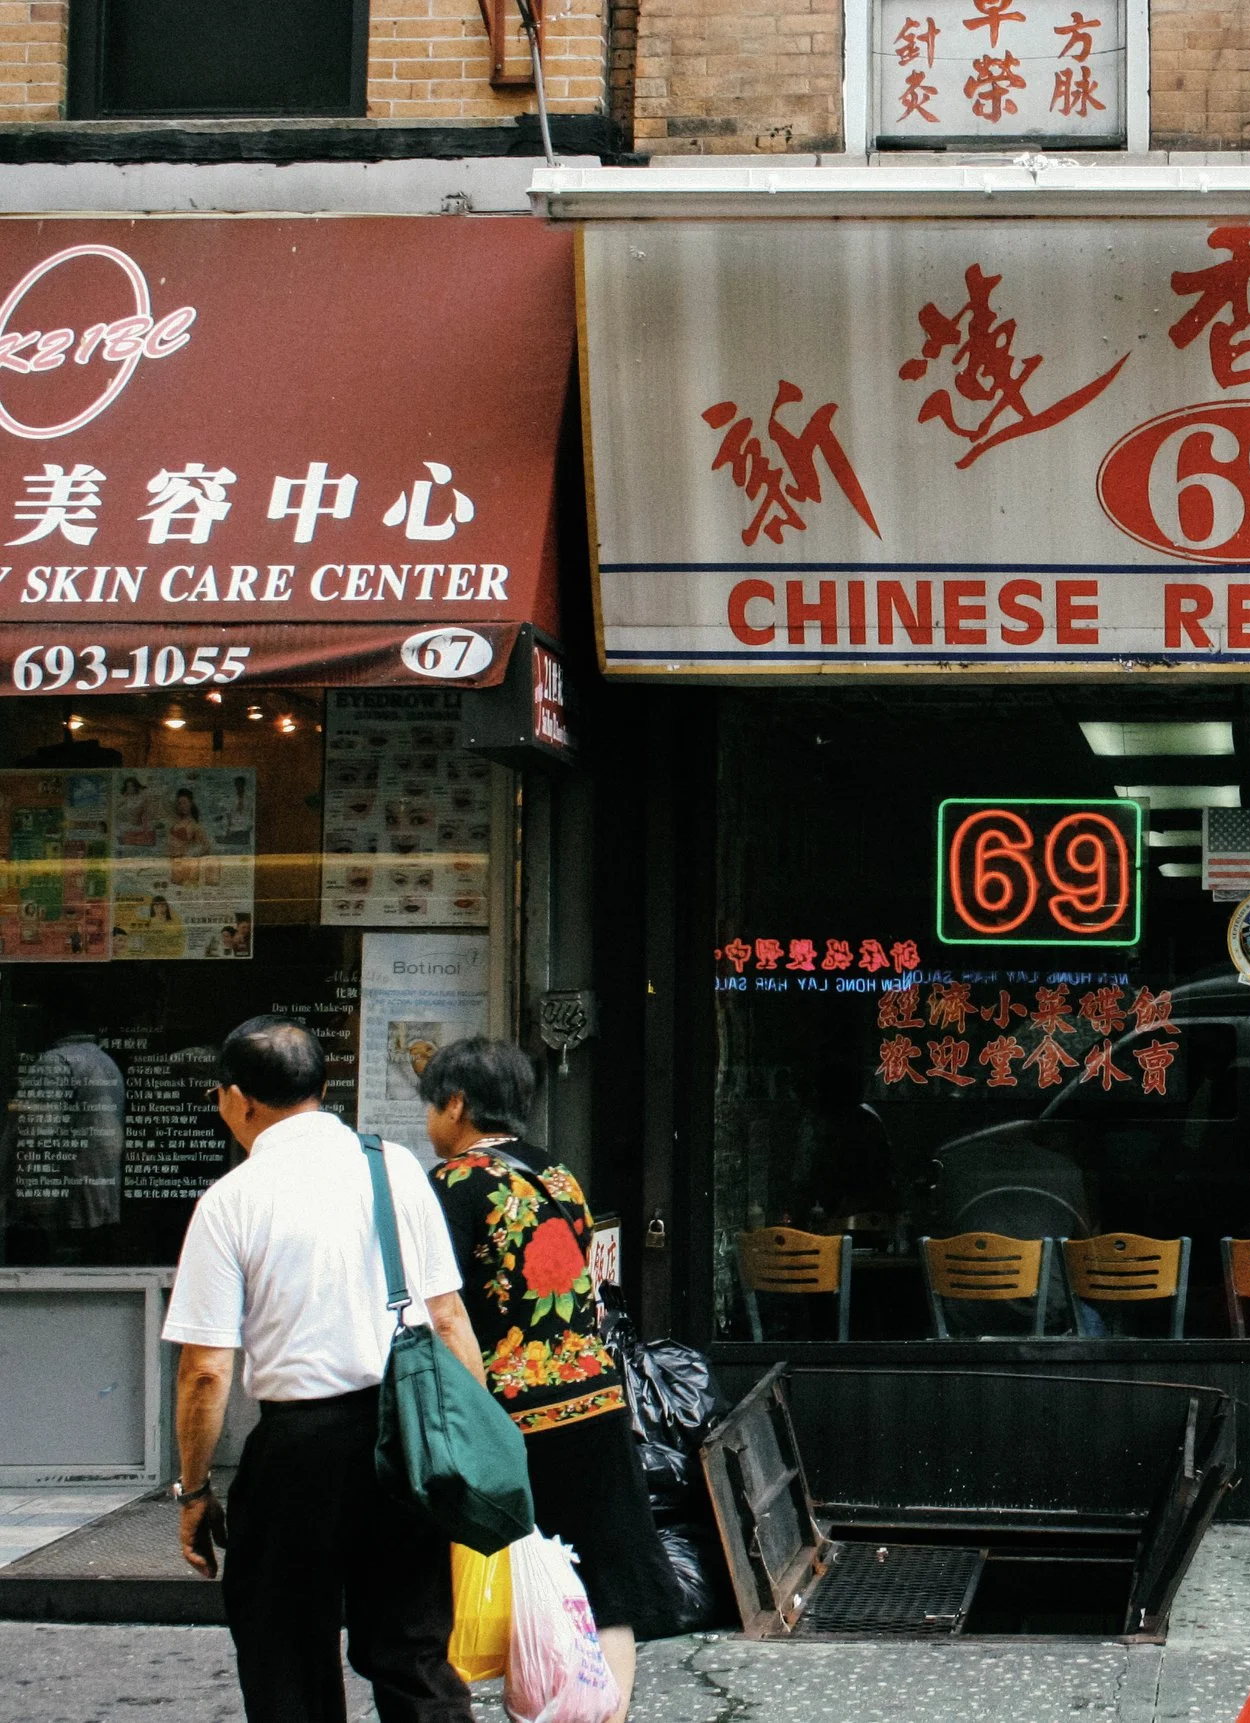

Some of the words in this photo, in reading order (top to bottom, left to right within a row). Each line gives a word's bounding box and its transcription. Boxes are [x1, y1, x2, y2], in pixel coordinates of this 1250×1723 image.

[893, 16, 942, 124] 針灸
[1049, 11, 1106, 118] 方脈
[4, 461, 475, 547] 美容中心
[21, 565, 148, 604] SKIN
[159, 564, 293, 603] CARE
[310, 563, 510, 602] CENTER
[727, 578, 1099, 647] CHINESE
[12, 646, 250, 692] 693-1055
[420, 634, 475, 672] 67
[949, 809, 1131, 934] 69
[271, 1003, 288, 1014] Day
[314, 1002, 354, 1015] Make-up
[877, 982, 1182, 1035] 經濟小菜碟飯
[324, 1052, 355, 1064] ake-up
[875, 1033, 1180, 1096] 歡迎堂食外賣
[126, 1127, 147, 1137] Bust
[155, 1127, 214, 1137] io-Treatment
